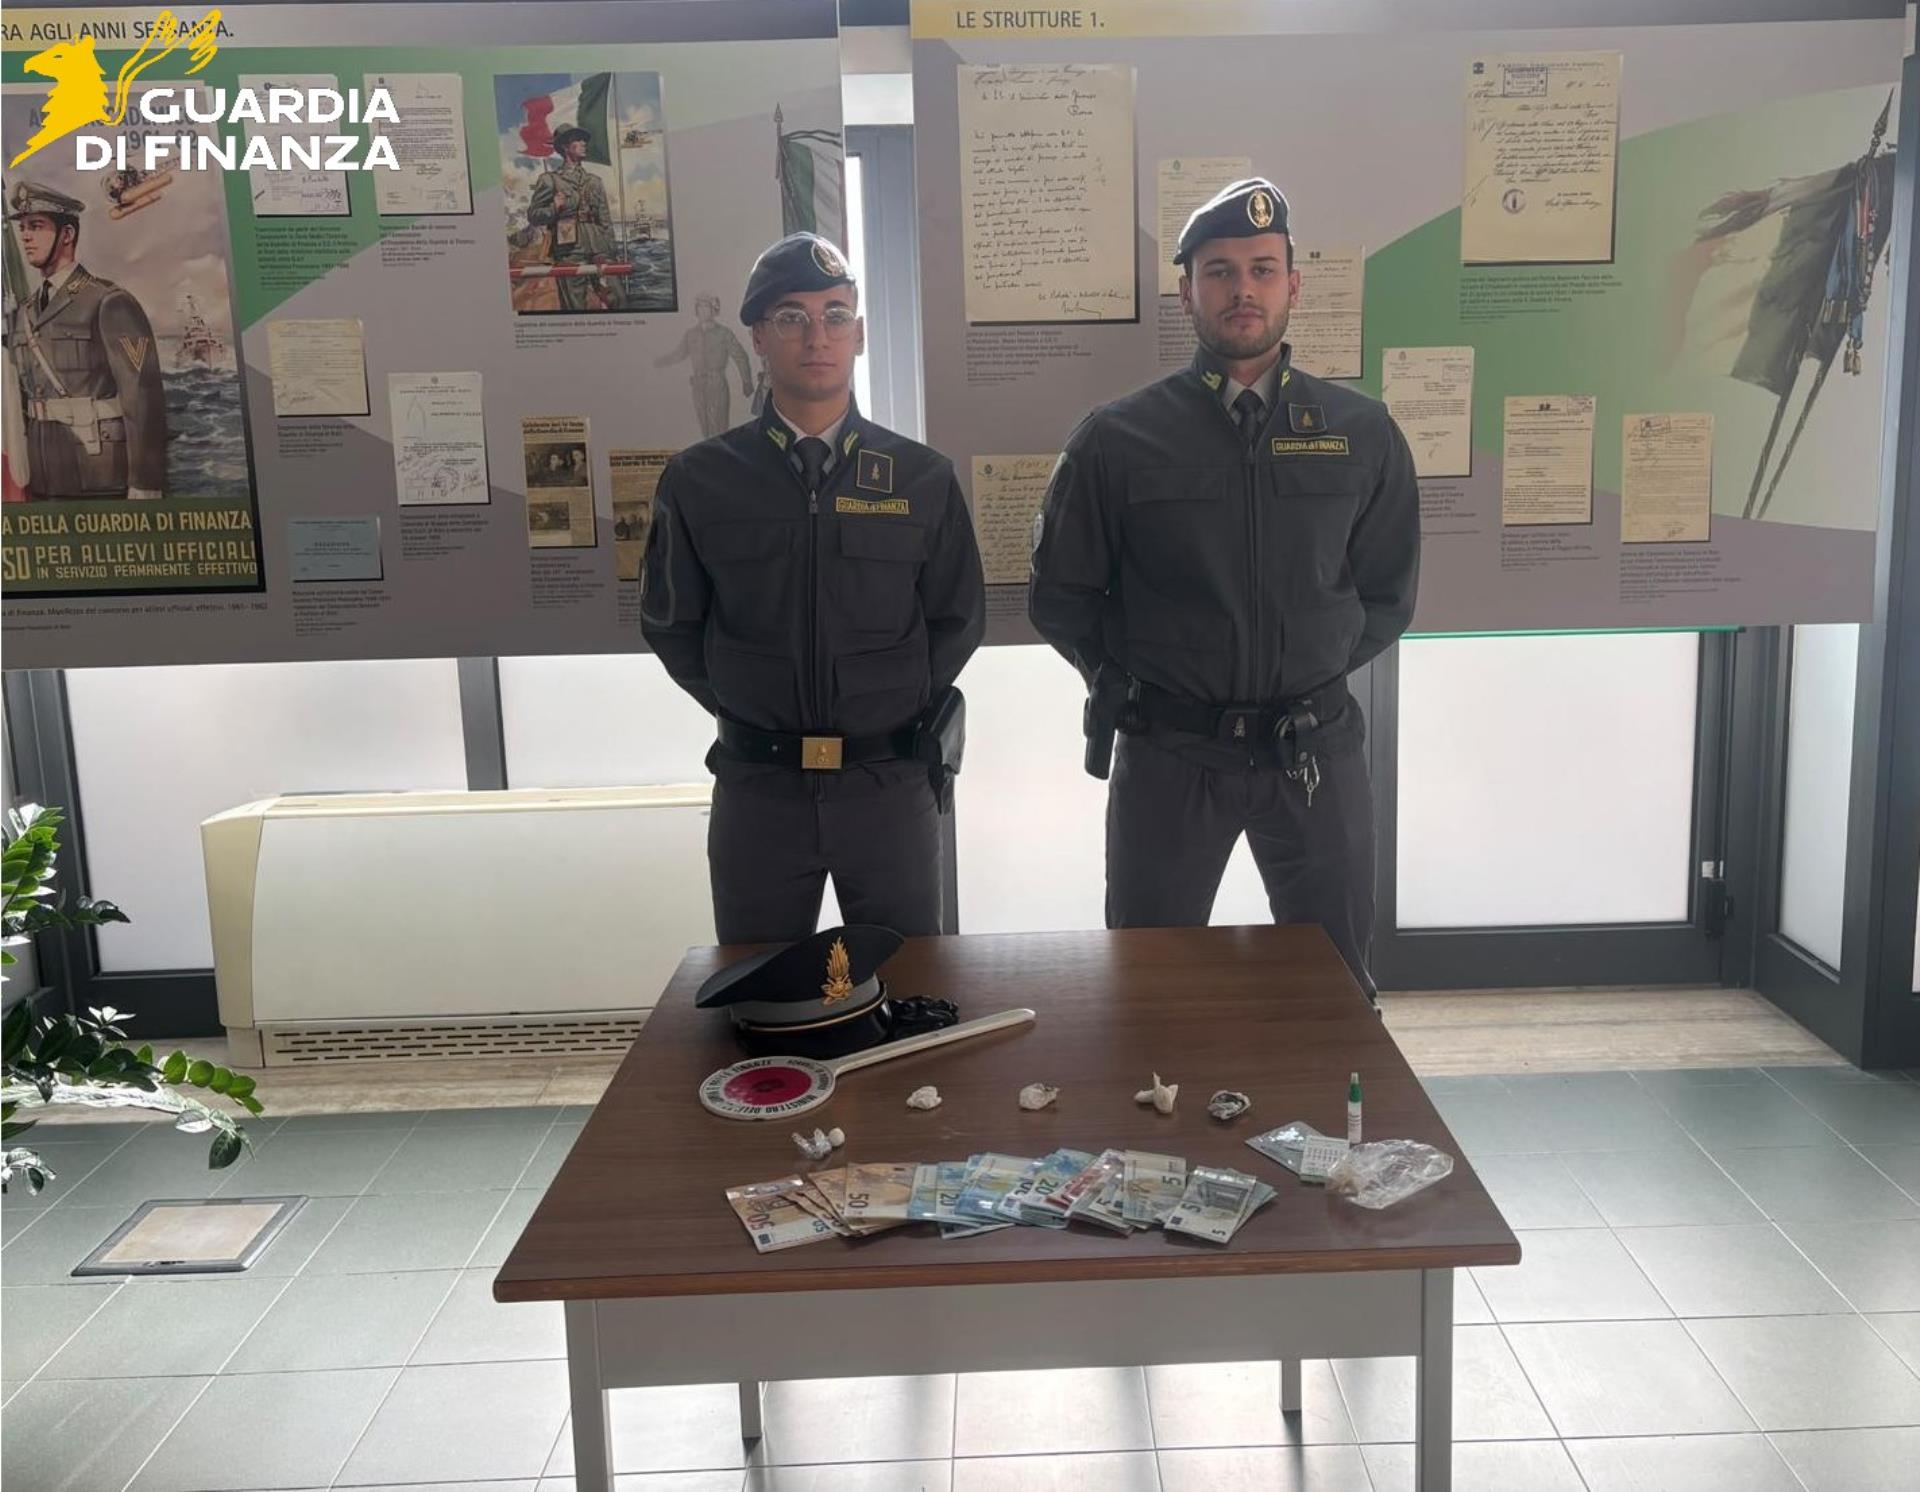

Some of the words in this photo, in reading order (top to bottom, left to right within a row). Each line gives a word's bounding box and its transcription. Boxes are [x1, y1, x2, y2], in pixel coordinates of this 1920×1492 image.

[957, 11, 976, 28] LE
[983, 11, 1082, 28] STRUTTURE
[1090, 12, 1105, 28] 1.
[30, 22, 72, 40] AGLI
[79, 21, 126, 39] ANNI
[1276, 441, 1307, 451] GUARDIA
[1318, 440, 1345, 450] FINANZA
[838, 500, 869, 512] GUARDIA
[880, 502, 906, 512] FINANZA
[2, 515, 13, 535] A
[18, 513, 69, 534] DELLA
[74, 512, 151, 534] GUARDIA
[156, 511, 174, 531] DI
[179, 510, 252, 531] FINANZA
[2, 546, 31, 580] SO
[35, 545, 72, 565] PER
[81, 542, 156, 564] ALLIEVI
[163, 540, 256, 562] UFFICIALI
[36, 566, 49, 579] IN
[55, 565, 107, 579] SERVIZIO
[114, 563, 190, 577] PERMANENTE
[197, 561, 257, 576] EFFETTIVO
[1035, 1178, 1058, 1195] 20
[1162, 1174, 1182, 1186] 5
[848, 1192, 870, 1209] 50
[940, 1192, 960, 1207] 20
